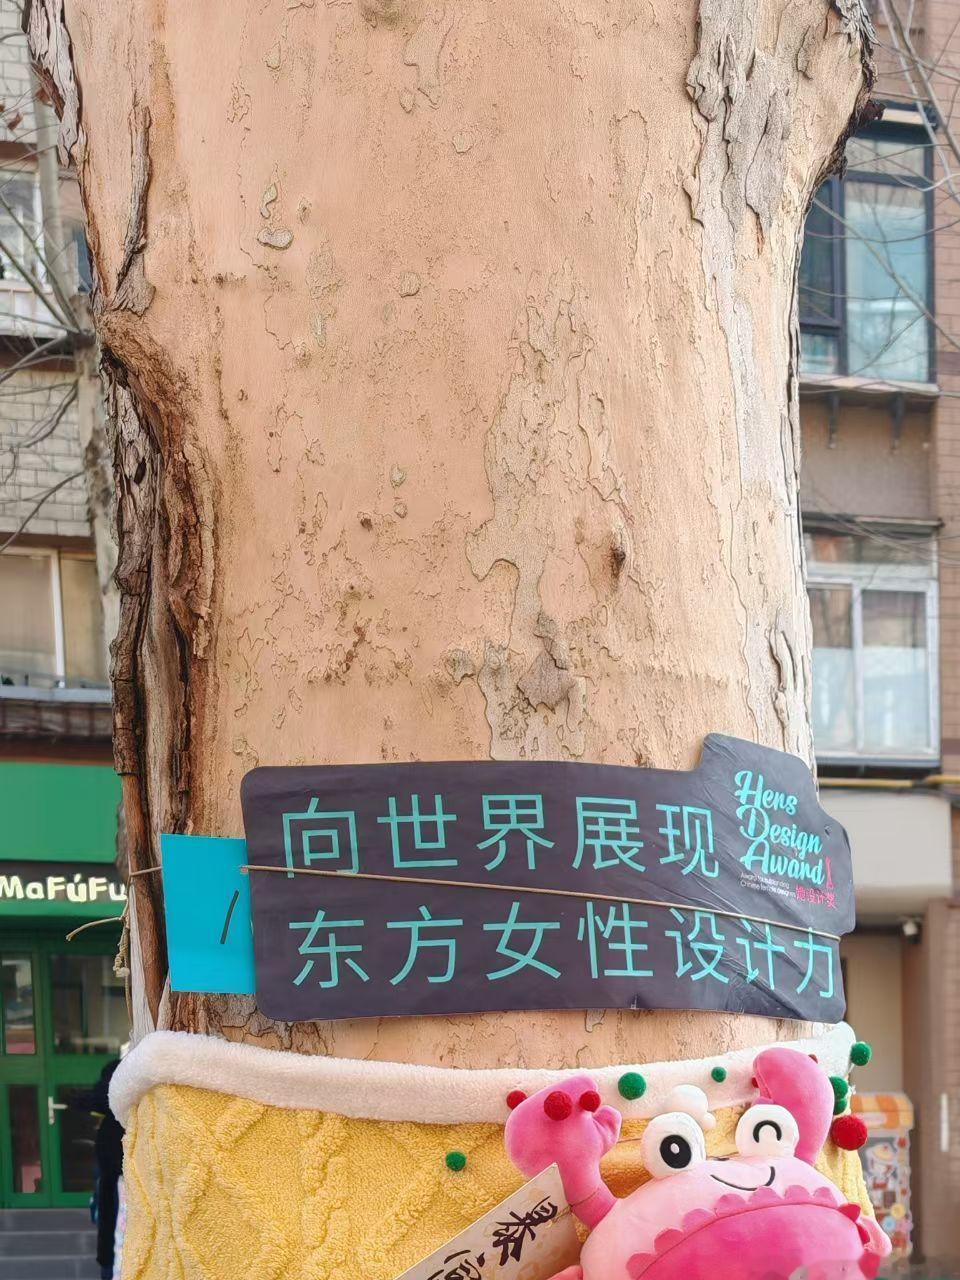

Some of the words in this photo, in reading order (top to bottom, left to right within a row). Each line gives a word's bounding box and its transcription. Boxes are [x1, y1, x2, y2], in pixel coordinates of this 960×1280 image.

[734, 770, 798, 816] Hens
[282, 795, 719, 879] 向世界展现
[735, 804, 823, 858] Design
[740, 839, 826, 885] Award
[288, 901, 834, 999] 东方女性设计力
